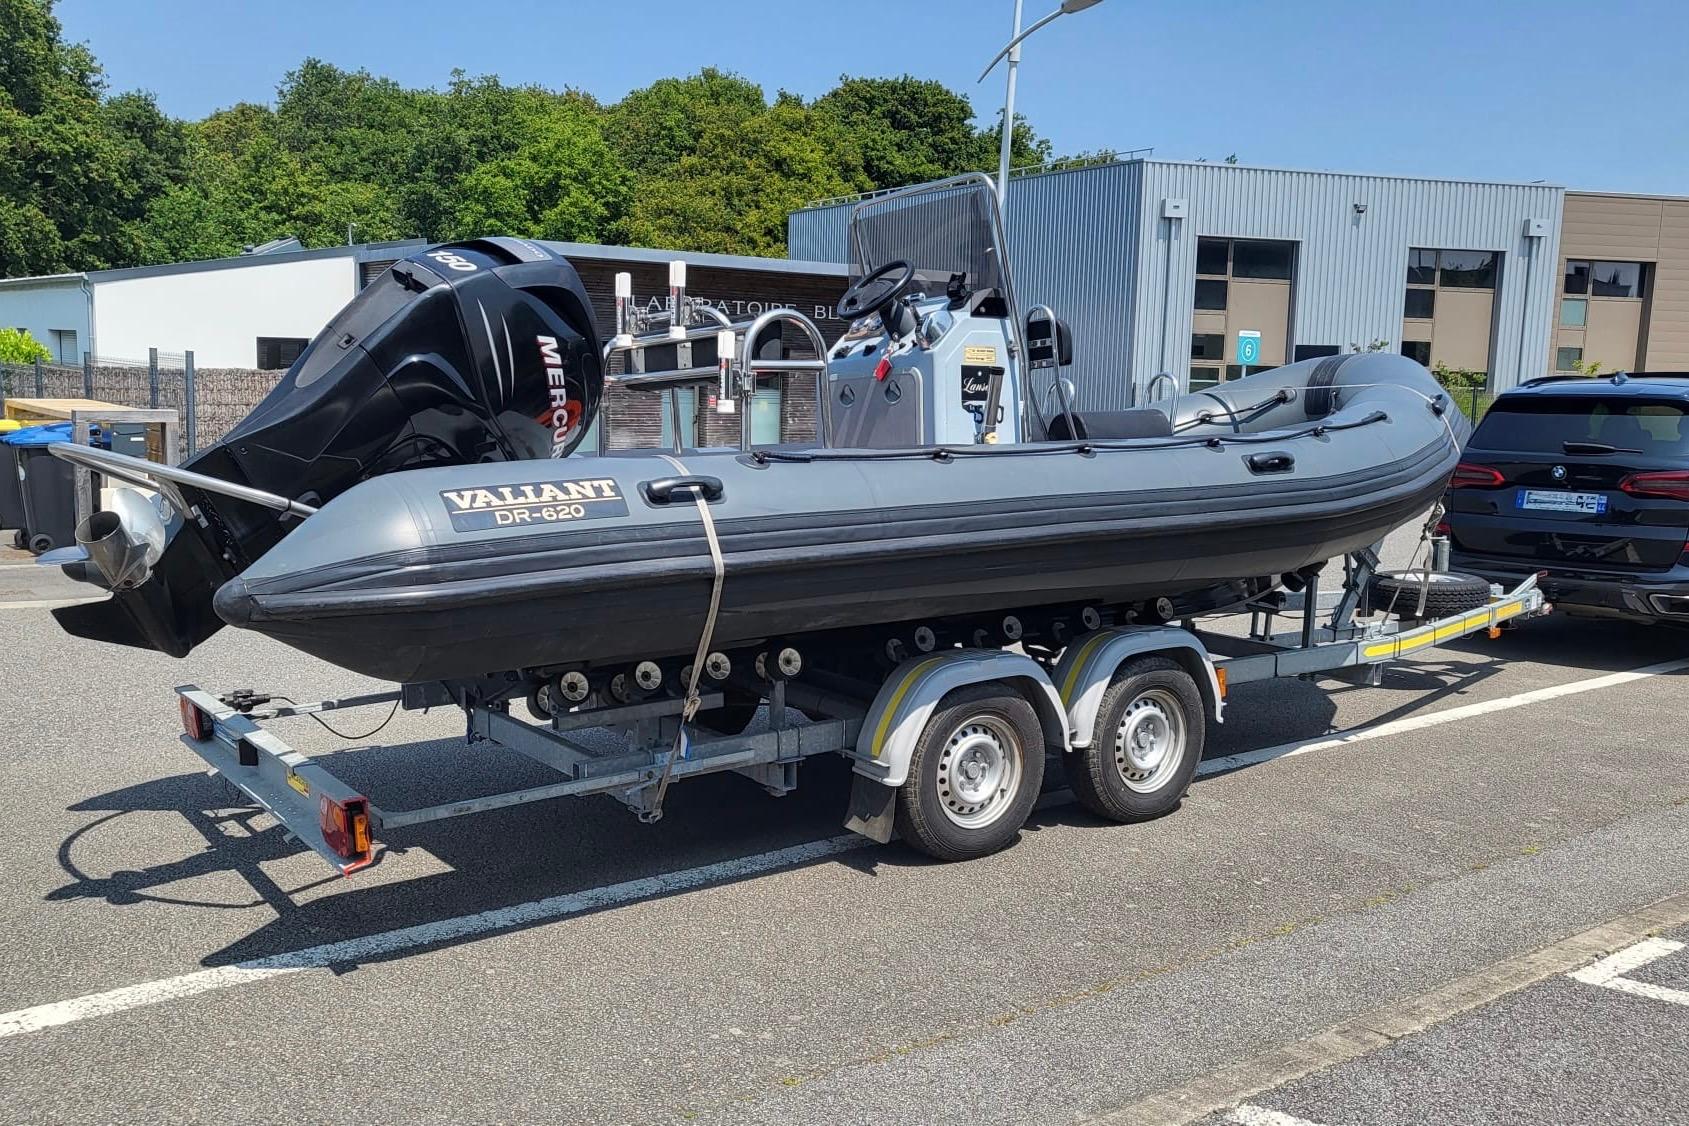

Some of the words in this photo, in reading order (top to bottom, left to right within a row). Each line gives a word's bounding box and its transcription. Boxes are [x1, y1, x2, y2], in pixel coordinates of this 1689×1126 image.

[427, 251, 478, 272] 150
[1245, 344, 1252, 357] 6
[443, 479, 617, 510] VALIANT
[494, 504, 586, 525] DR-620
